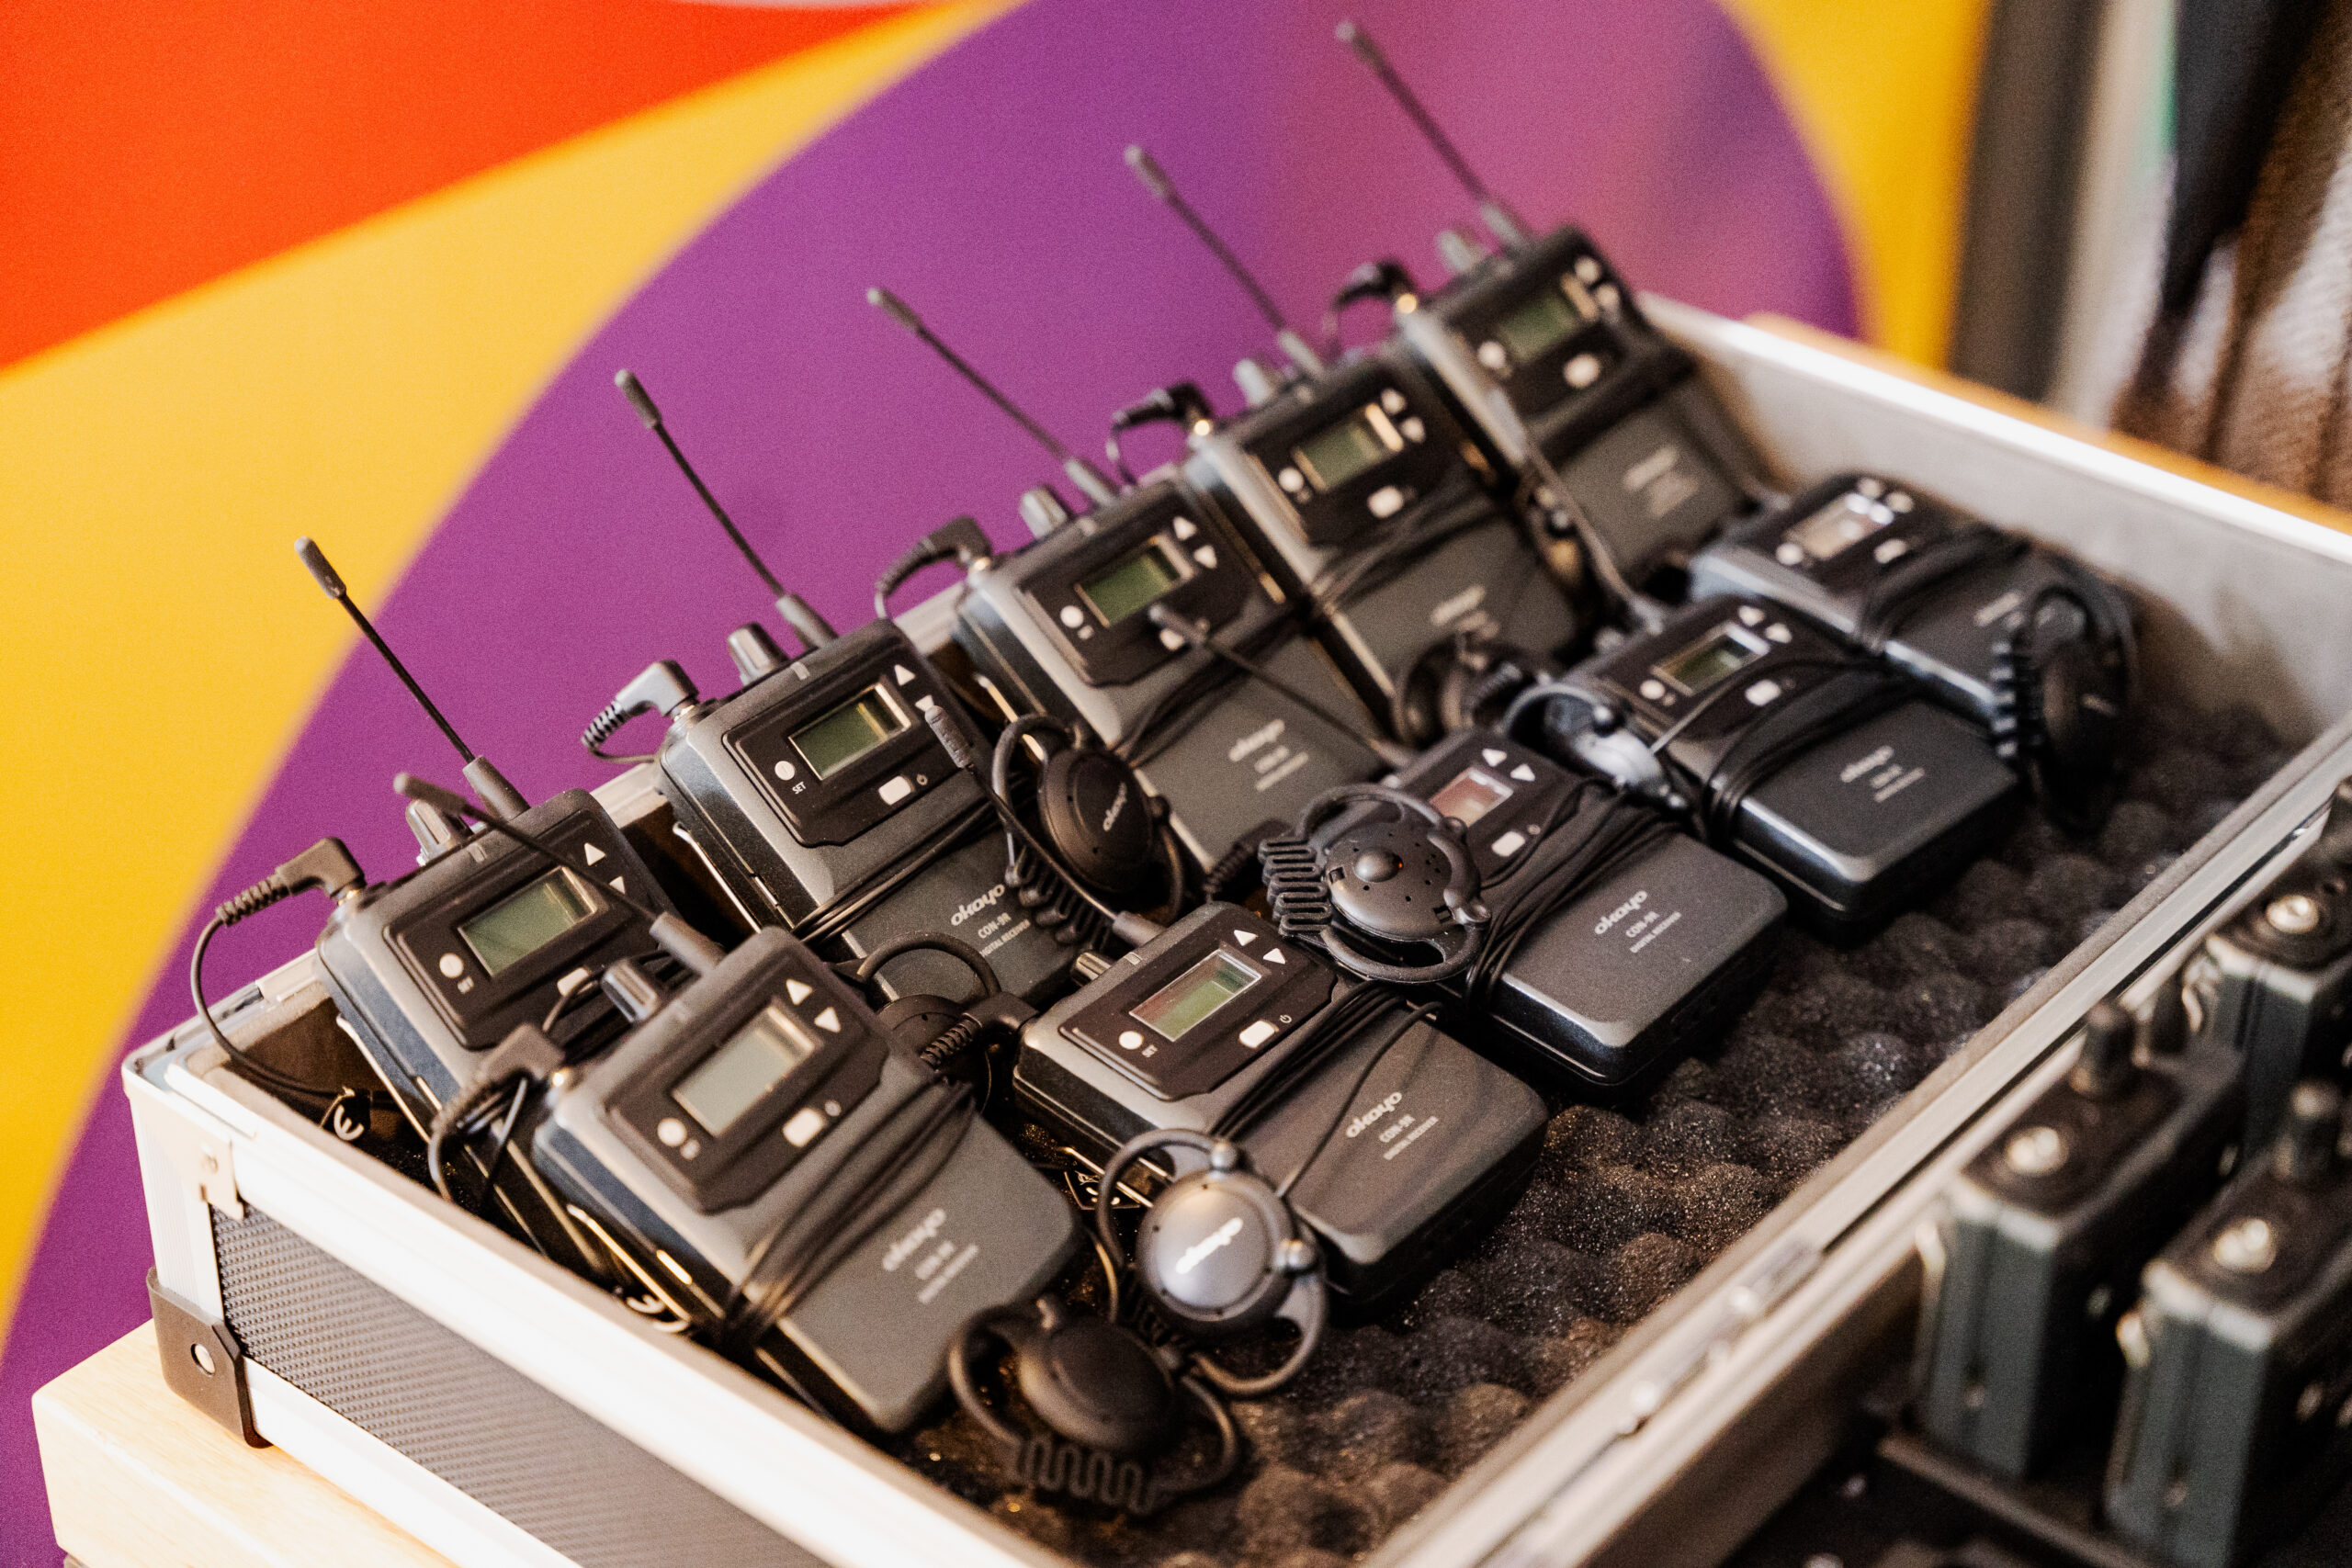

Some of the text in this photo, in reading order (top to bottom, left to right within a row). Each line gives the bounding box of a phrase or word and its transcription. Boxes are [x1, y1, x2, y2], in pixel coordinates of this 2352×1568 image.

[792, 781, 806, 795] SET
[951, 884, 1005, 926] okayo
[978, 912, 1012, 939] CON-9R
[1594, 891, 1647, 935] okayo
[1346, 1091, 1403, 1138] okayo
